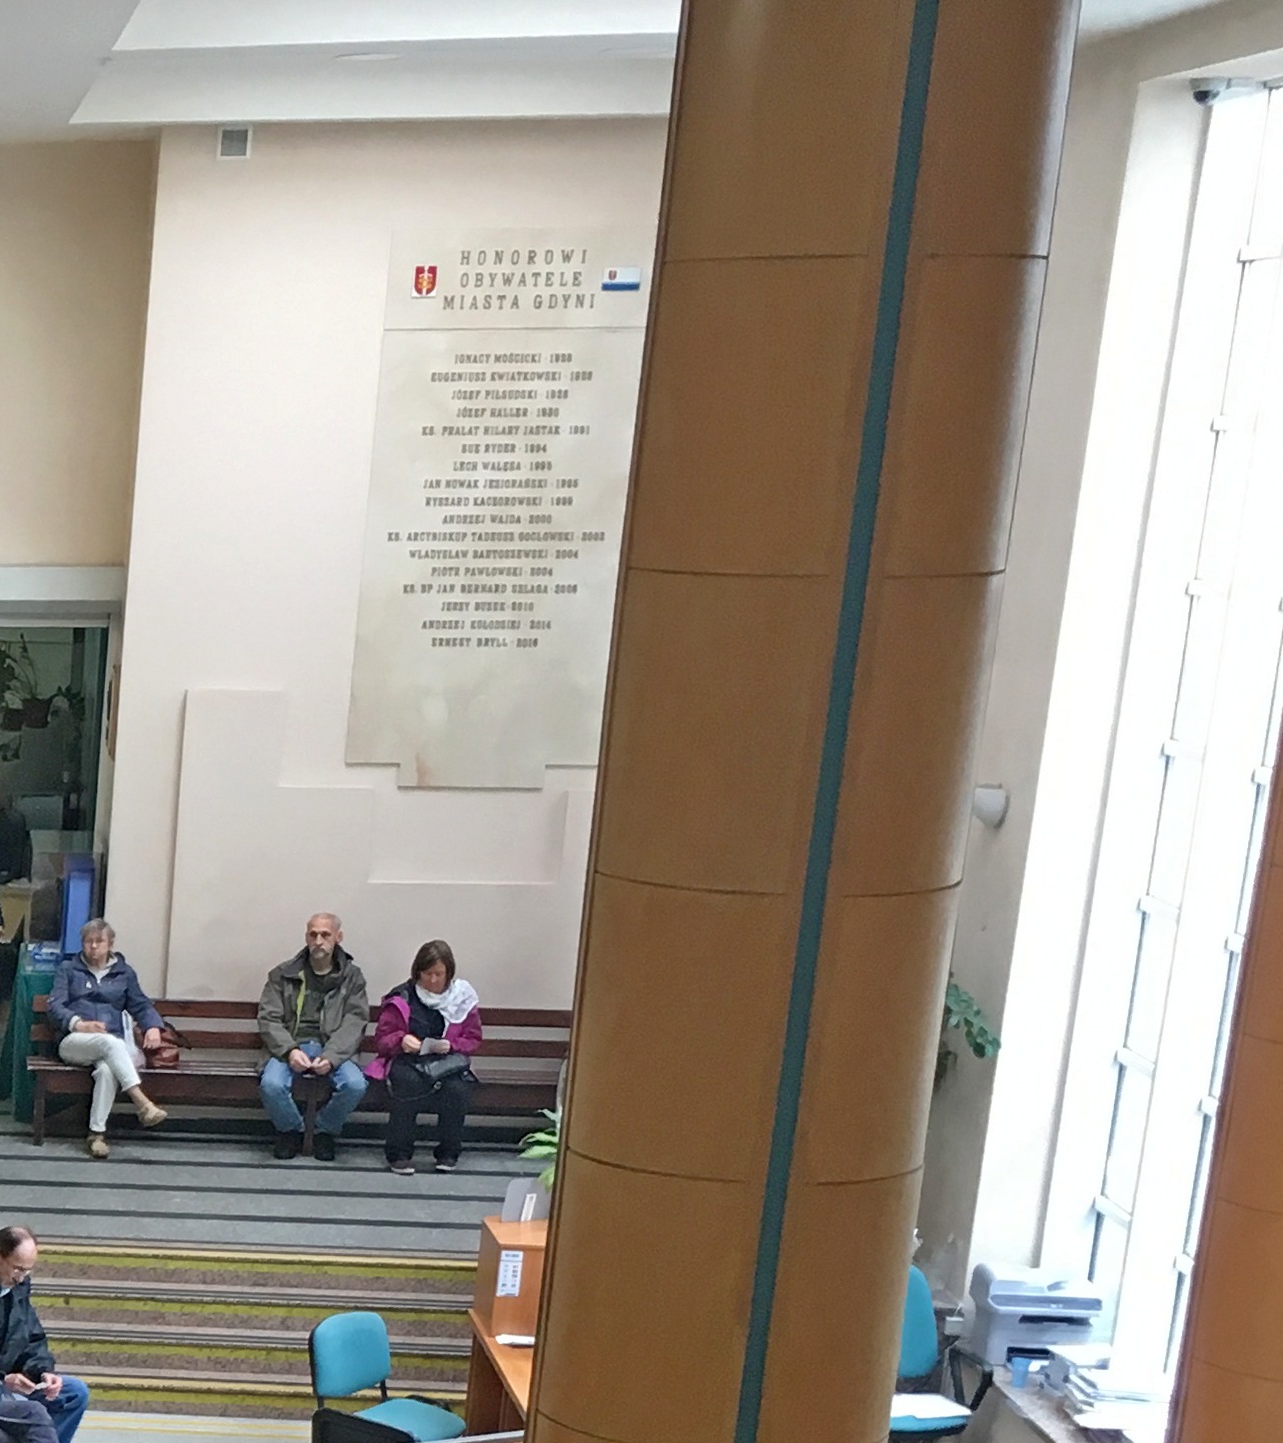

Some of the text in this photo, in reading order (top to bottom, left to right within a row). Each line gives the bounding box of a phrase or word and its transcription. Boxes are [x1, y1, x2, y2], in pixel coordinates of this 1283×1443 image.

[460, 249, 587, 266] HONOROWI
[460, 271, 583, 288] OBYWATELE
[442, 293, 596, 310] MIASTA GDYNI
[454, 353, 491, 364] IGNACY
[431, 371, 486, 382] EUGENIUSZ
[490, 371, 561, 382] KWIATKOWSKI
[490, 407, 528, 418] HALLER
[483, 425, 520, 436] HILARY
[484, 443, 516, 454] RYDER
[453, 461, 478, 472] LECH
[423, 478, 441, 489] JAN
[445, 478, 479, 489] NOWAK
[425, 496, 470, 507] RYSZARD
[473, 496, 543, 507] KACZOROWSKI
[442, 514, 486, 525] ANDRZEJ
[490, 514, 521, 525] WAJDA
[406, 531, 468, 542] ARCYBISKUP
[431, 566, 460, 577] PIOTR
[436, 584, 456, 595] JAN
[460, 584, 507, 595] BERNARD
[421, 620, 465, 630] ANDRZEJ
[431, 637, 472, 648] ERNEST
[476, 637, 508, 648] BRYLL
